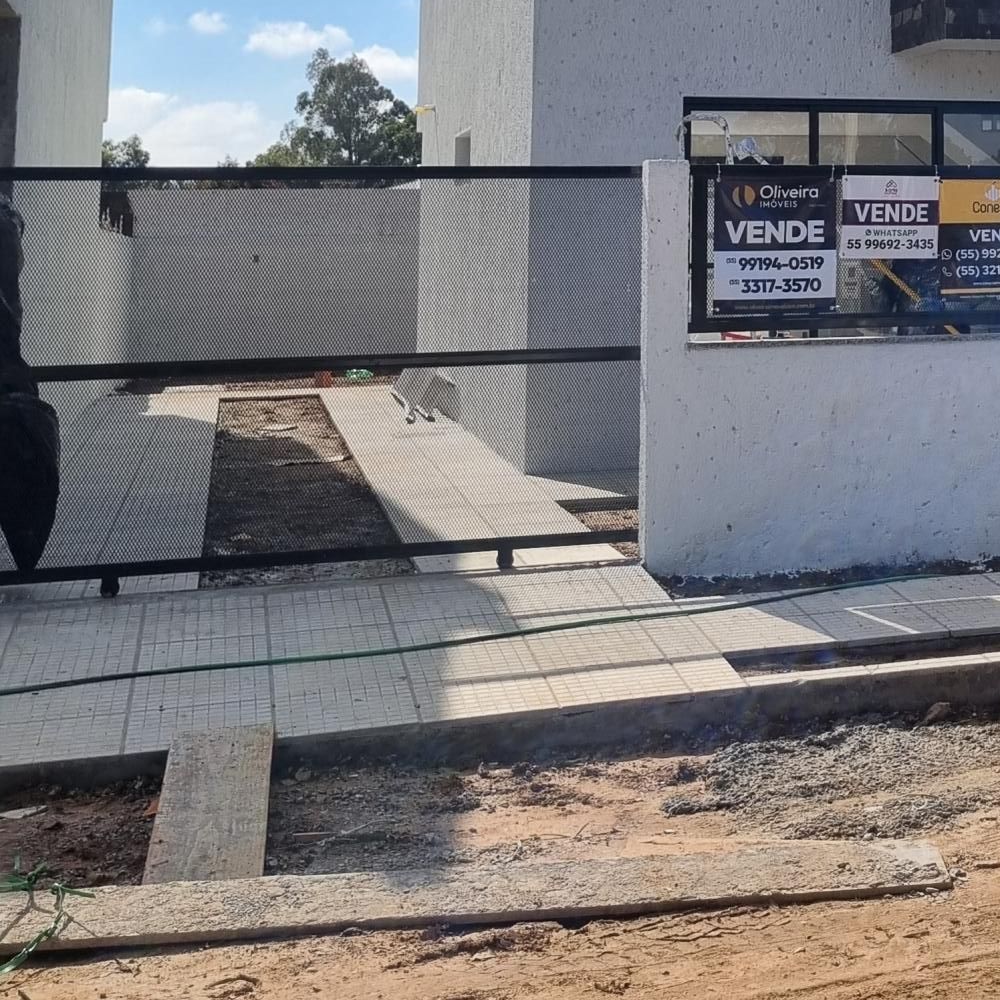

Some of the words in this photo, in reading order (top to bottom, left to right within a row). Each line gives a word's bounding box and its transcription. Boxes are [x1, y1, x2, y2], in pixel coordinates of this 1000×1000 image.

[759, 185, 819, 199] Oliveira
[759, 200, 798, 208] IMÓVEIS
[854, 203, 928, 222] VENDE
[725, 220, 825, 244] VENDE
[847, 239, 861, 249] 55
[865, 239, 934, 249] 99692-3435
[956, 249, 979, 261] (55)
[738, 256, 825, 271] 99194-0519
[956, 265, 980, 278] (55)
[741, 278, 822, 293] 3317-3570
